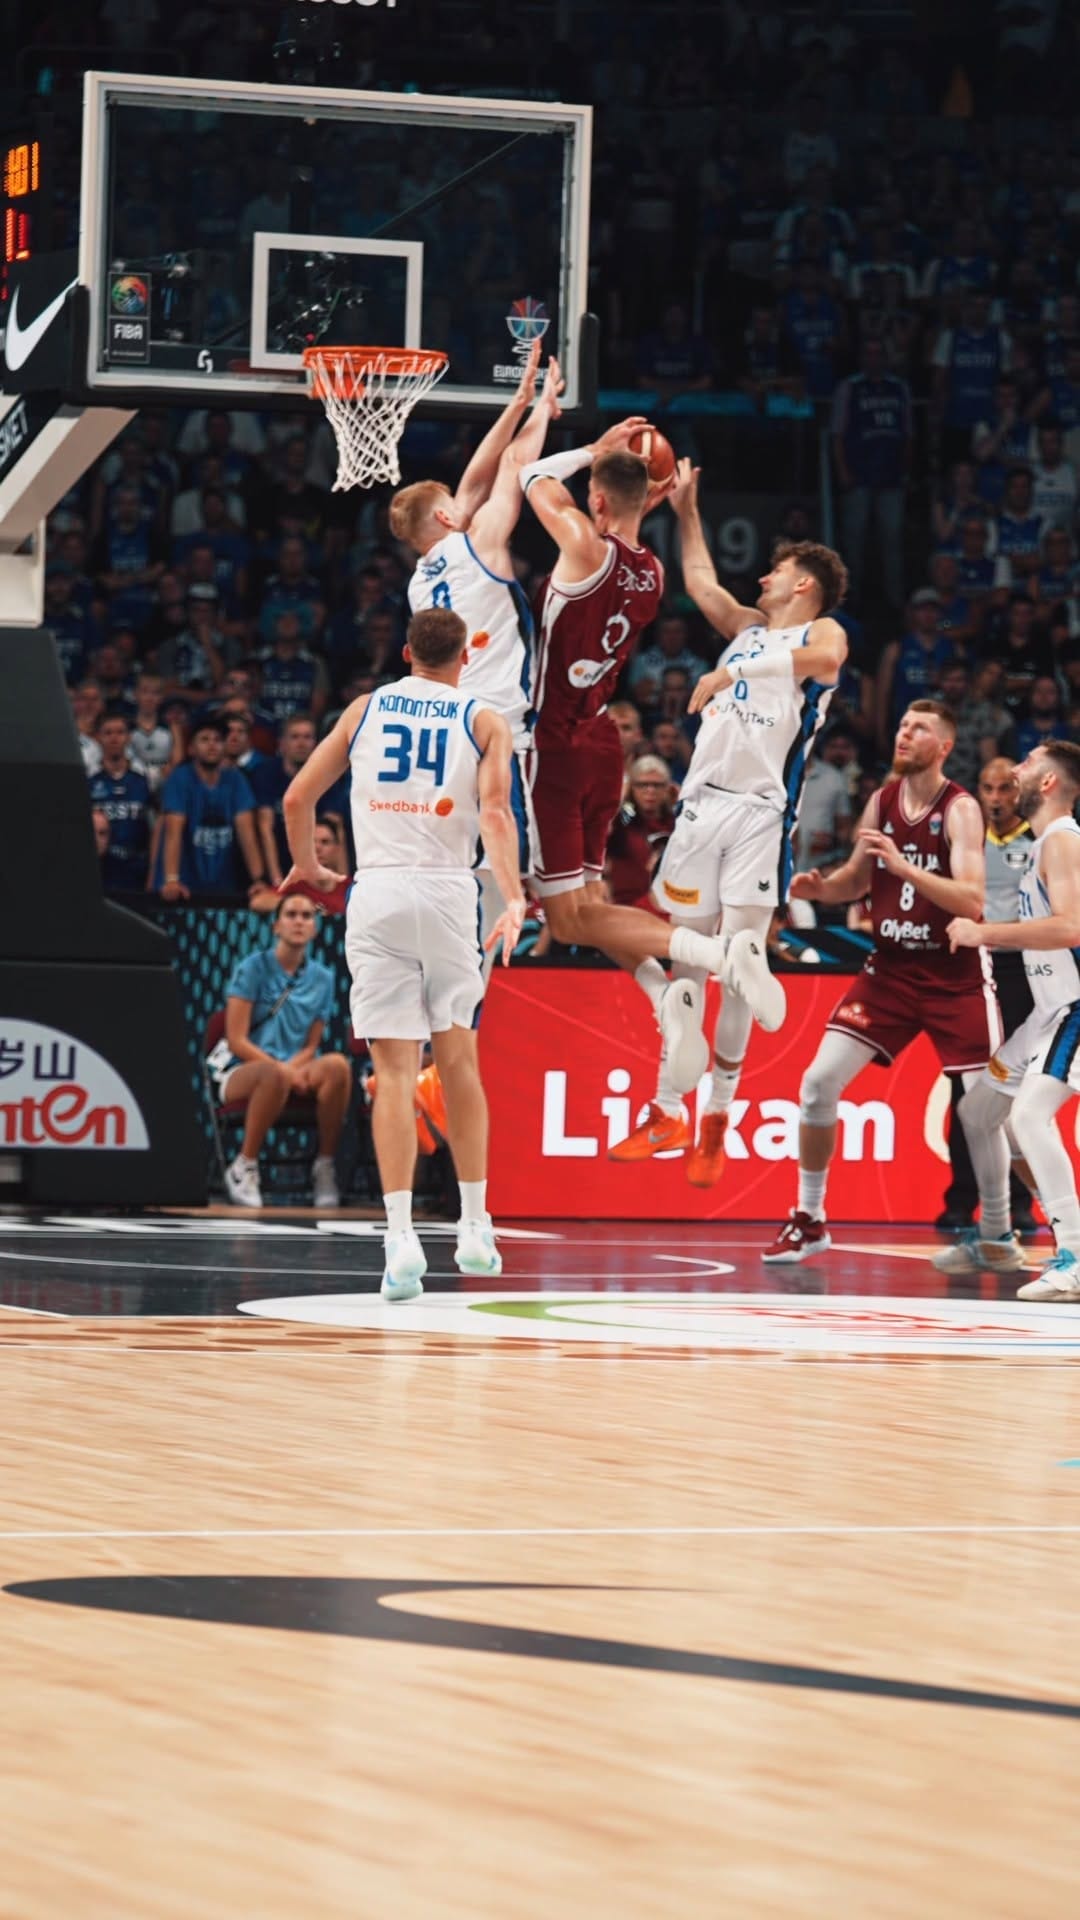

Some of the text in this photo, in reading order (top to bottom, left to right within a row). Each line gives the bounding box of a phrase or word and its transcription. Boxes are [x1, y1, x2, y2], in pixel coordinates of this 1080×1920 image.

[114, 323, 143, 340] FIBA
[378, 695, 460, 719] KONONTSUK
[377, 723, 449, 787] 34
[369, 799, 431, 815] Swedbank
[899, 881, 915, 911] 8
[880, 919, 931, 942] OlyBet
